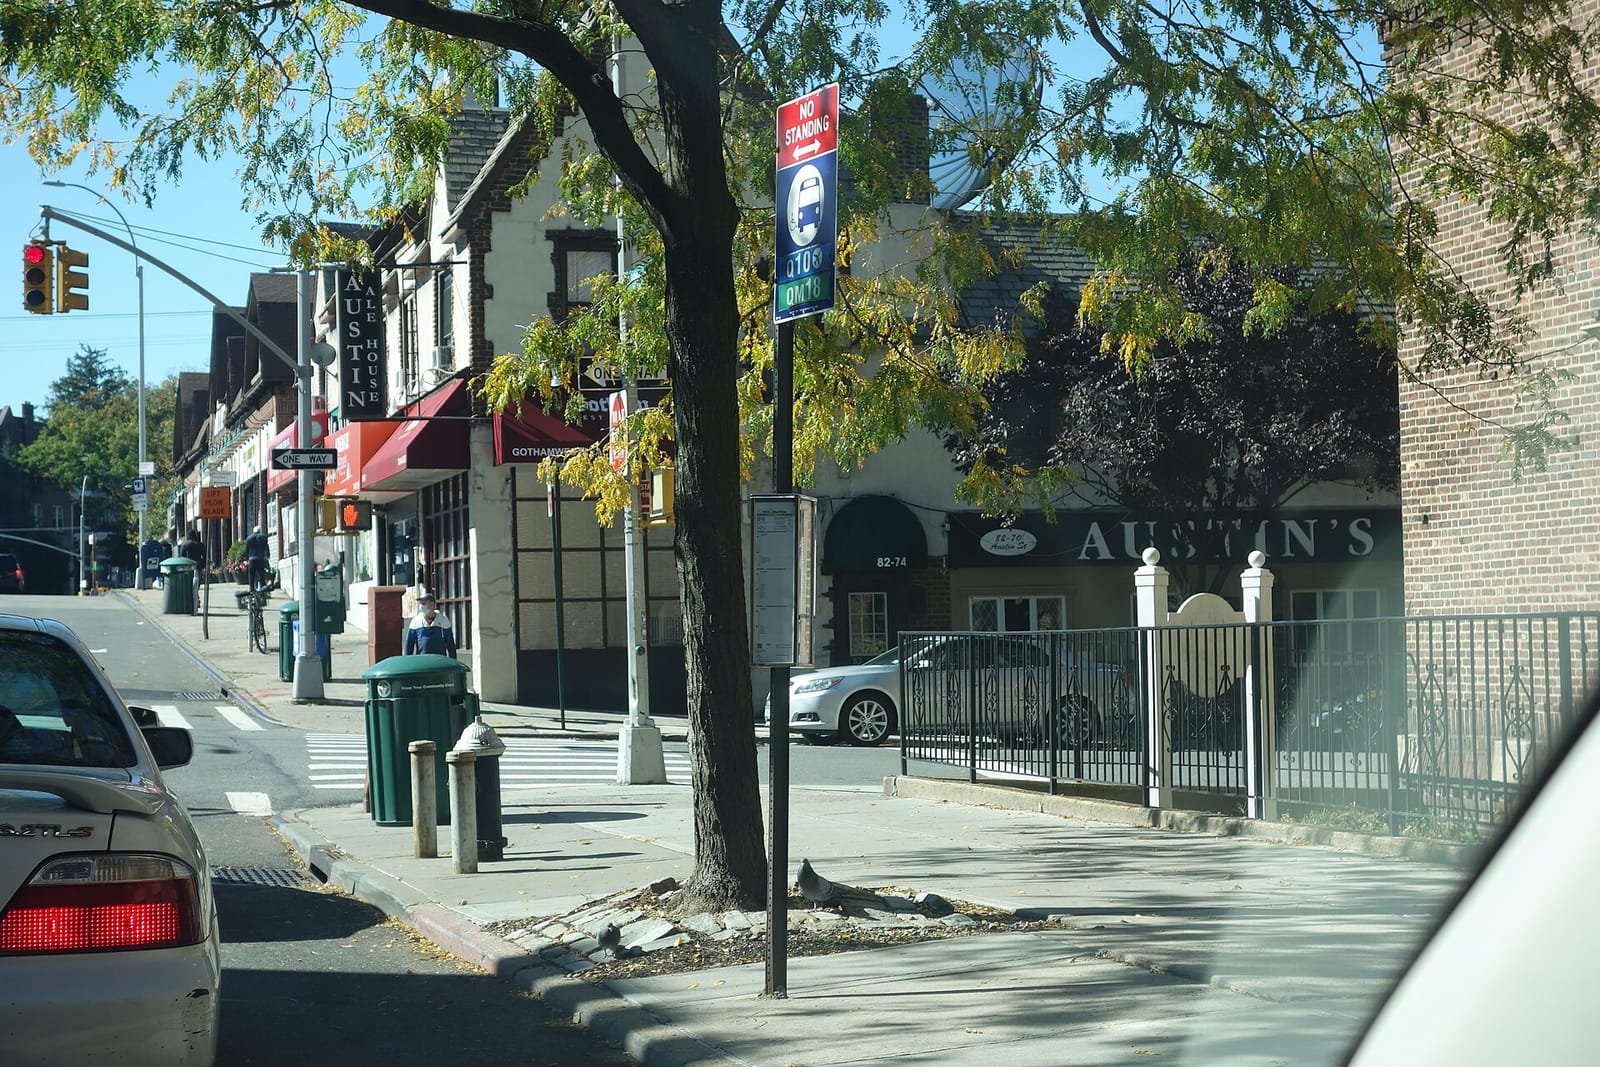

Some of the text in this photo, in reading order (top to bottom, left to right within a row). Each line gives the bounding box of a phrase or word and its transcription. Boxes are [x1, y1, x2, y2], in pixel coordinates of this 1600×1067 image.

[799, 99, 815, 121] NO
[785, 114, 830, 146] STANDING
[786, 276, 821, 306] QM18
[344, 275, 365, 407] AUSTIN
[365, 286, 380, 402] ALE HOUSE
[282, 455, 328, 464] ONE WAY
[995, 534, 1022, 542] 82-70
[876, 557, 907, 568] 82-74
